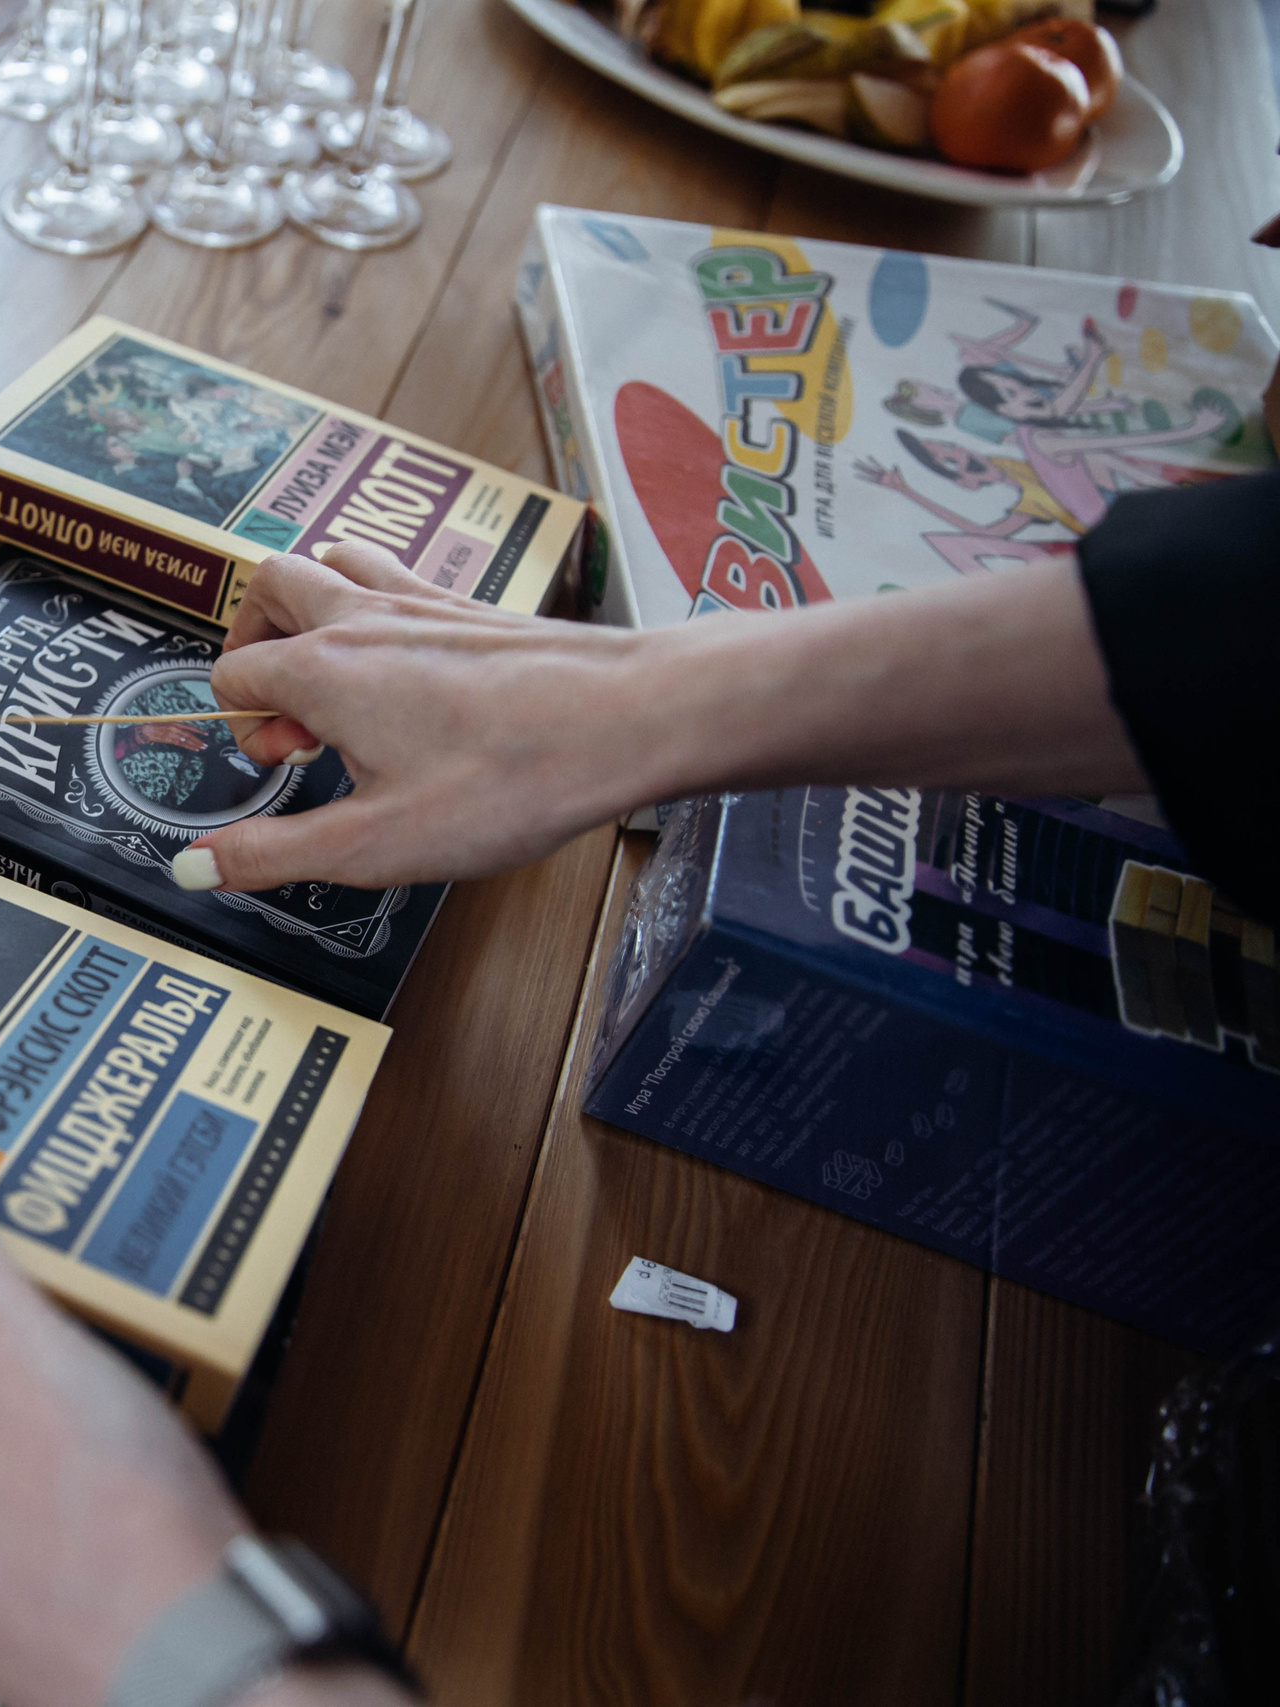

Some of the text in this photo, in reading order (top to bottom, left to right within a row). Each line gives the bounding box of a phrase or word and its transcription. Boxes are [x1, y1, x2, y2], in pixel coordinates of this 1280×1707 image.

[268, 412, 366, 525] ЛУИЗА МЭЙ
[686, 241, 836, 620] ВИСТЕР
[97, 530, 141, 564] МЭЙ
[311, 439, 459, 563] ЛКОТТ
[816, 498, 835, 539] ИГРА
[145, 548, 208, 588] ЛУИЗА
[950, 791, 984, 986] игра «Постро
[53, 945, 128, 1018] СКОТТ
[987, 920, 1014, 987] свою
[4, 973, 222, 1233] ФИЦДЖЕРАЛЬД
[622, 1084, 656, 1118] Игра
[640, 1033, 692, 1093] "Построй
[680, 1004, 712, 1039] свою
